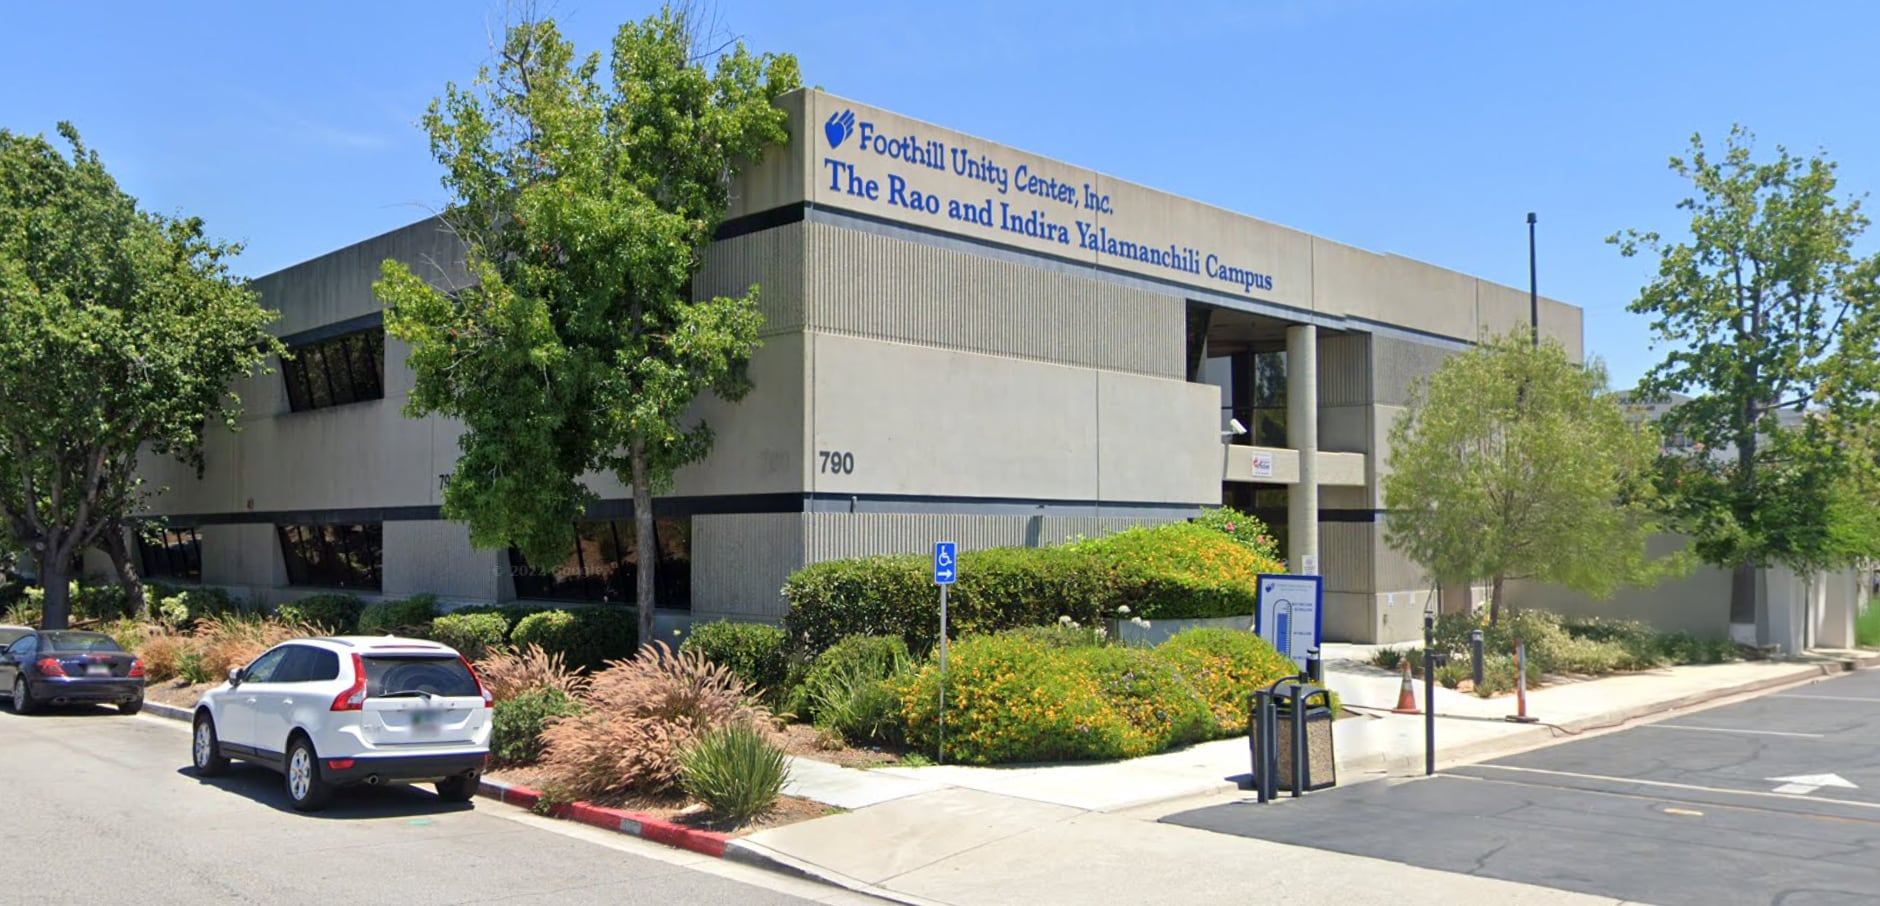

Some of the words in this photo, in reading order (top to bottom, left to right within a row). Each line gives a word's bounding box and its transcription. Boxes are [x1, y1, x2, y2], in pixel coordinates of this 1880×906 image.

[859, 121, 945, 171] Foothill
[951, 147, 1008, 194] Unity
[1014, 164, 1079, 209] Center,
[1083, 183, 1114, 216] Inc.
[824, 158, 880, 201] The
[888, 173, 940, 214] Rao
[948, 199, 994, 227] and
[1000, 202, 1070, 244] Indira
[1076, 220, 1200, 275] Yalamanchili
[1205, 254, 1273, 292] Campus
[438, 473, 456, 491] 79
[819, 450, 855, 475] 790
